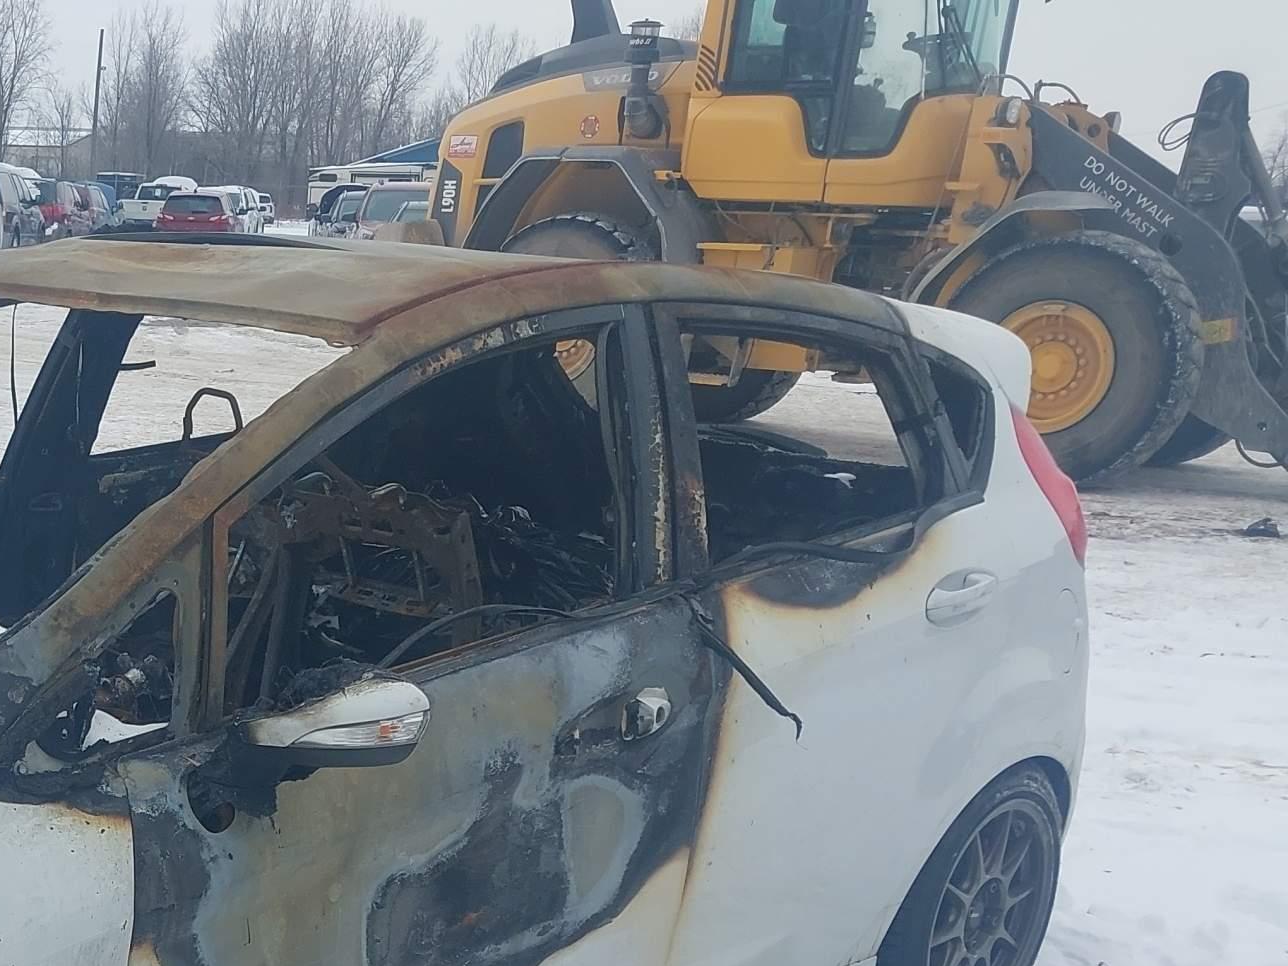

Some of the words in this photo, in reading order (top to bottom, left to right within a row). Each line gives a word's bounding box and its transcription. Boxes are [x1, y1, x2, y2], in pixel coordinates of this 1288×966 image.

[440, 180, 457, 213] L90H
[1084, 156, 1105, 175] DO
[1105, 171, 1137, 198] NOT
[1136, 193, 1175, 229] WALK
[1121, 208, 1158, 238] MAST
